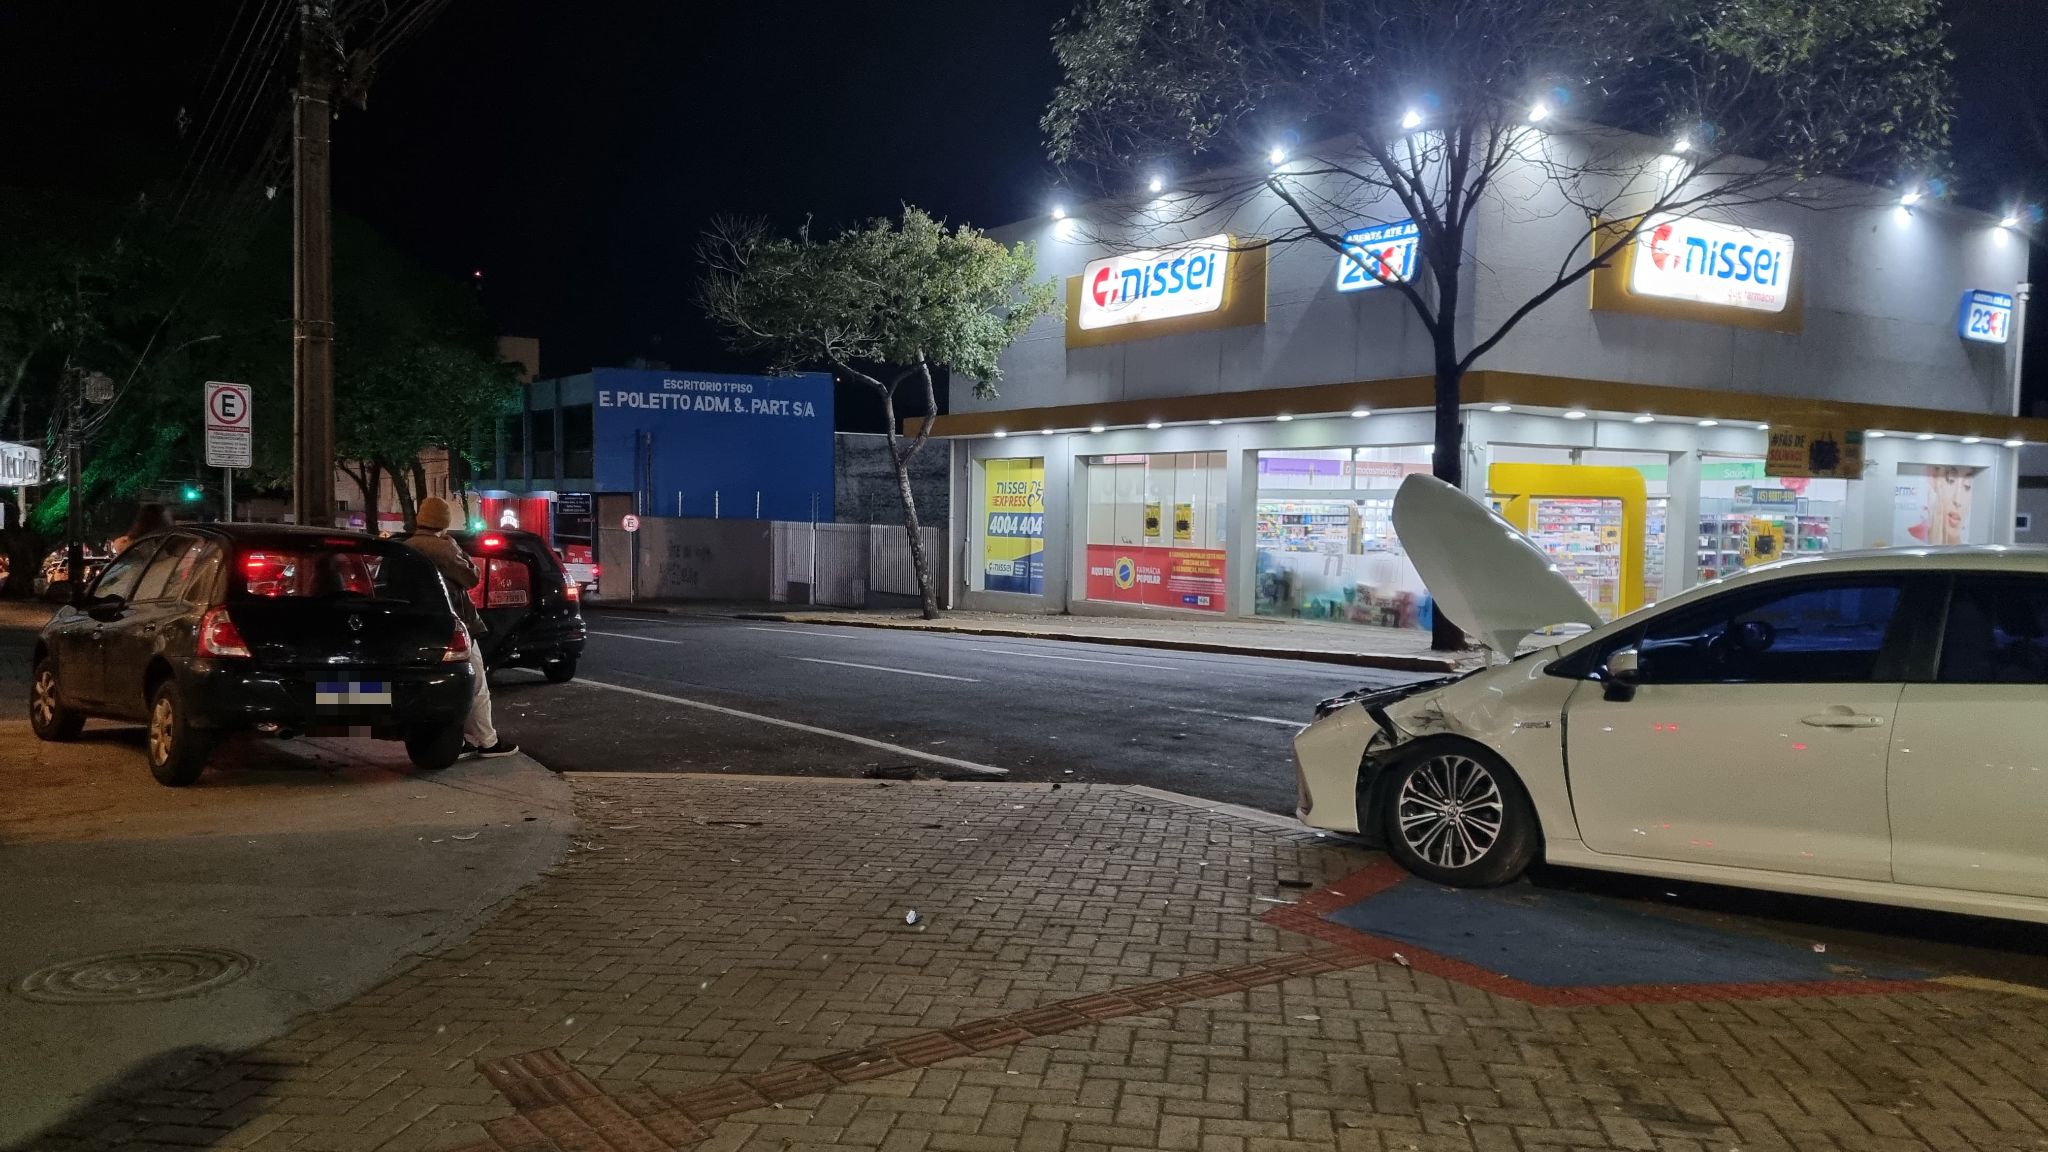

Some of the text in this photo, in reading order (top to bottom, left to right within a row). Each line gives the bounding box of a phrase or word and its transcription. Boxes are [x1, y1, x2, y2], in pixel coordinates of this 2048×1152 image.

[1685, 236, 1781, 287] nissei
[1121, 253, 1216, 302] nissei
[663, 379, 721, 392] ESCRITÓRIO
[222, 394, 236, 417] E
[599, 391, 614, 407] E.
[616, 391, 691, 410] POLETTO
[694, 396, 732, 413] ADM.
[751, 399, 789, 416] PART.
[793, 401, 815, 418] S/A
[996, 481, 1027, 495] nissei
[991, 495, 1026, 507] EXPRESS
[989, 515, 1018, 534] 4004
[1136, 574, 1160, 585] POPULAR
